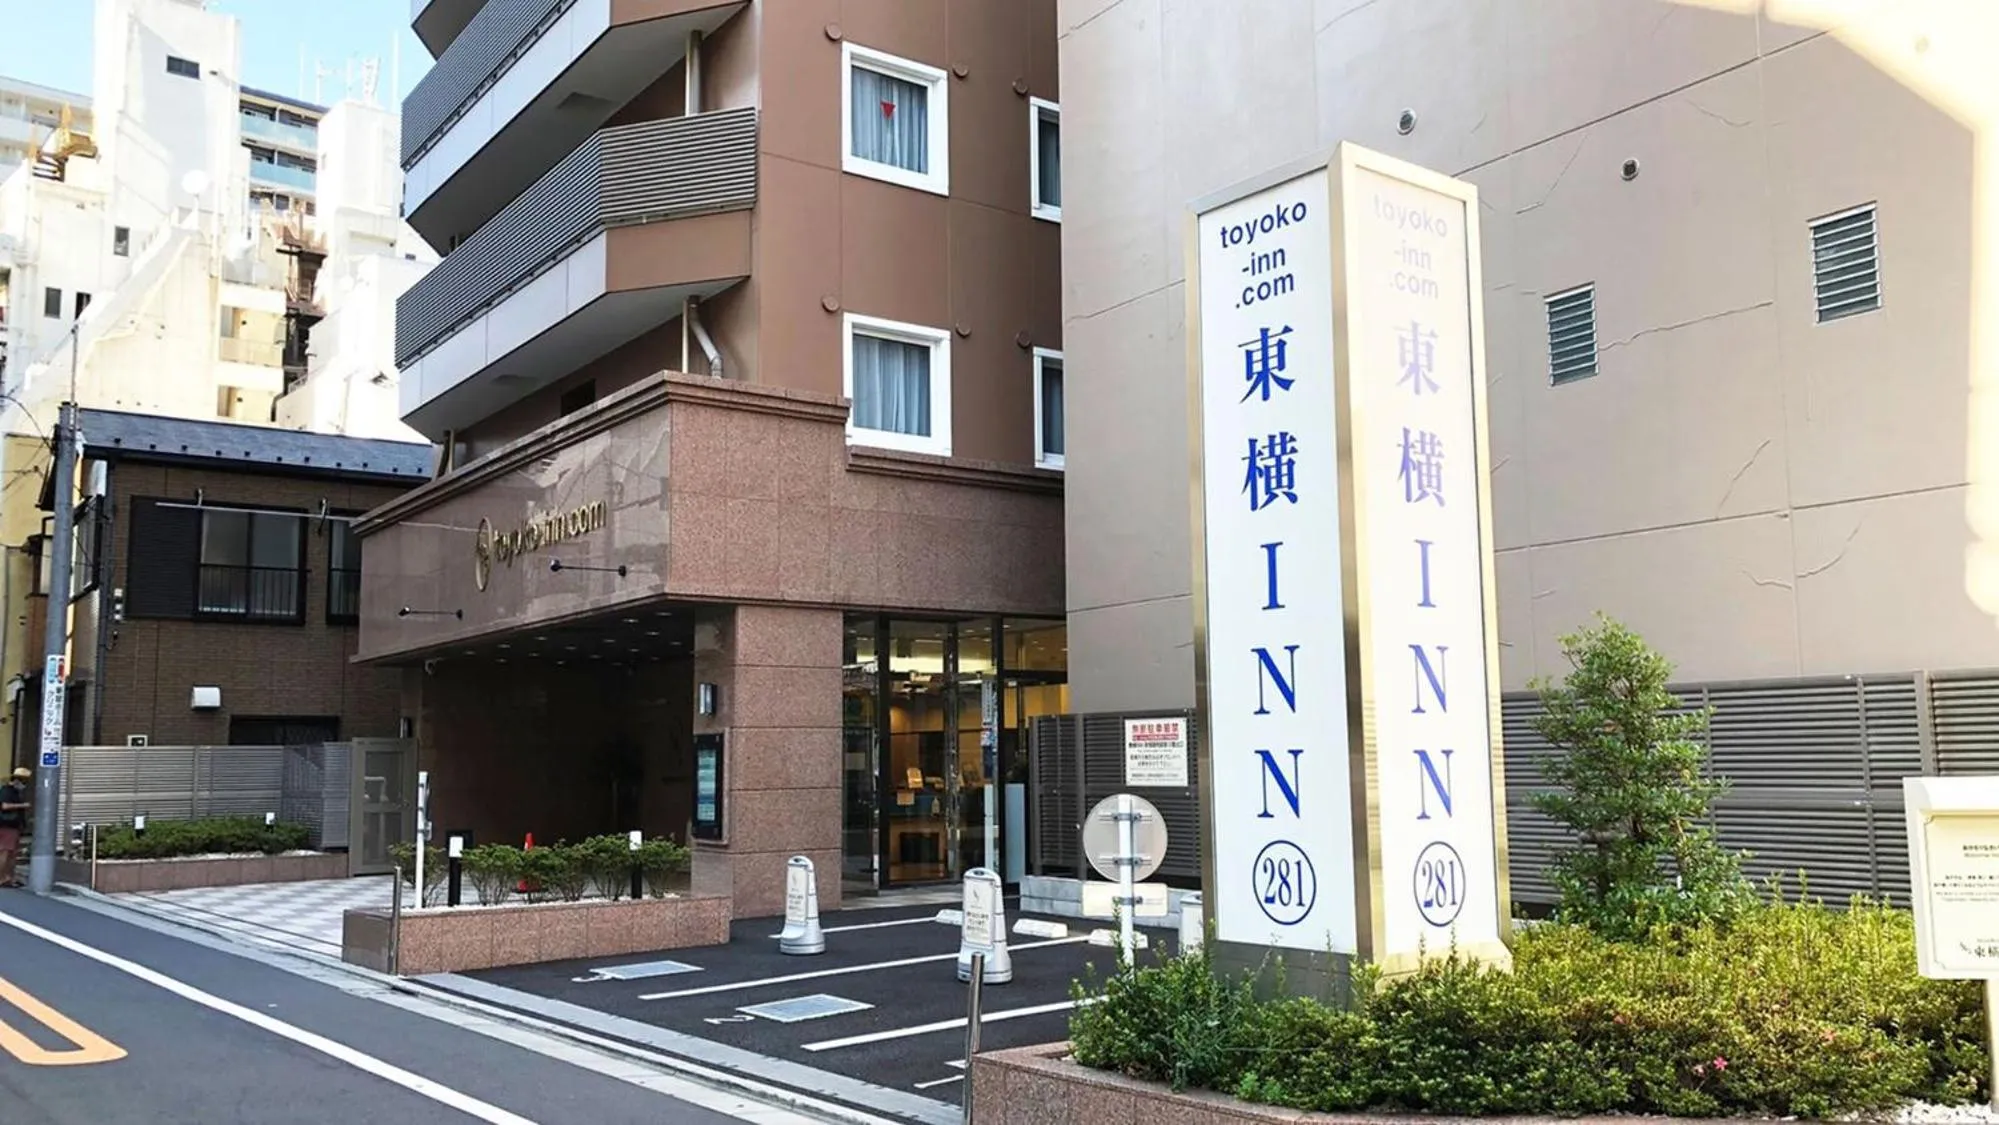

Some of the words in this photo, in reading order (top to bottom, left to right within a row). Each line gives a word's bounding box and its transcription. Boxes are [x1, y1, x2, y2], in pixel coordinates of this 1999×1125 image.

[1220, 202, 1308, 248] toyoko
[1373, 194, 1449, 238] toyoko
[1242, 248, 1286, 276] -inn
[1394, 240, 1433, 271] -inn
[1235, 271, 1295, 309] .com
[1389, 271, 1439, 301] .com
[1262, 856, 1306, 908] 281
[1421, 857, 1458, 908] 281
